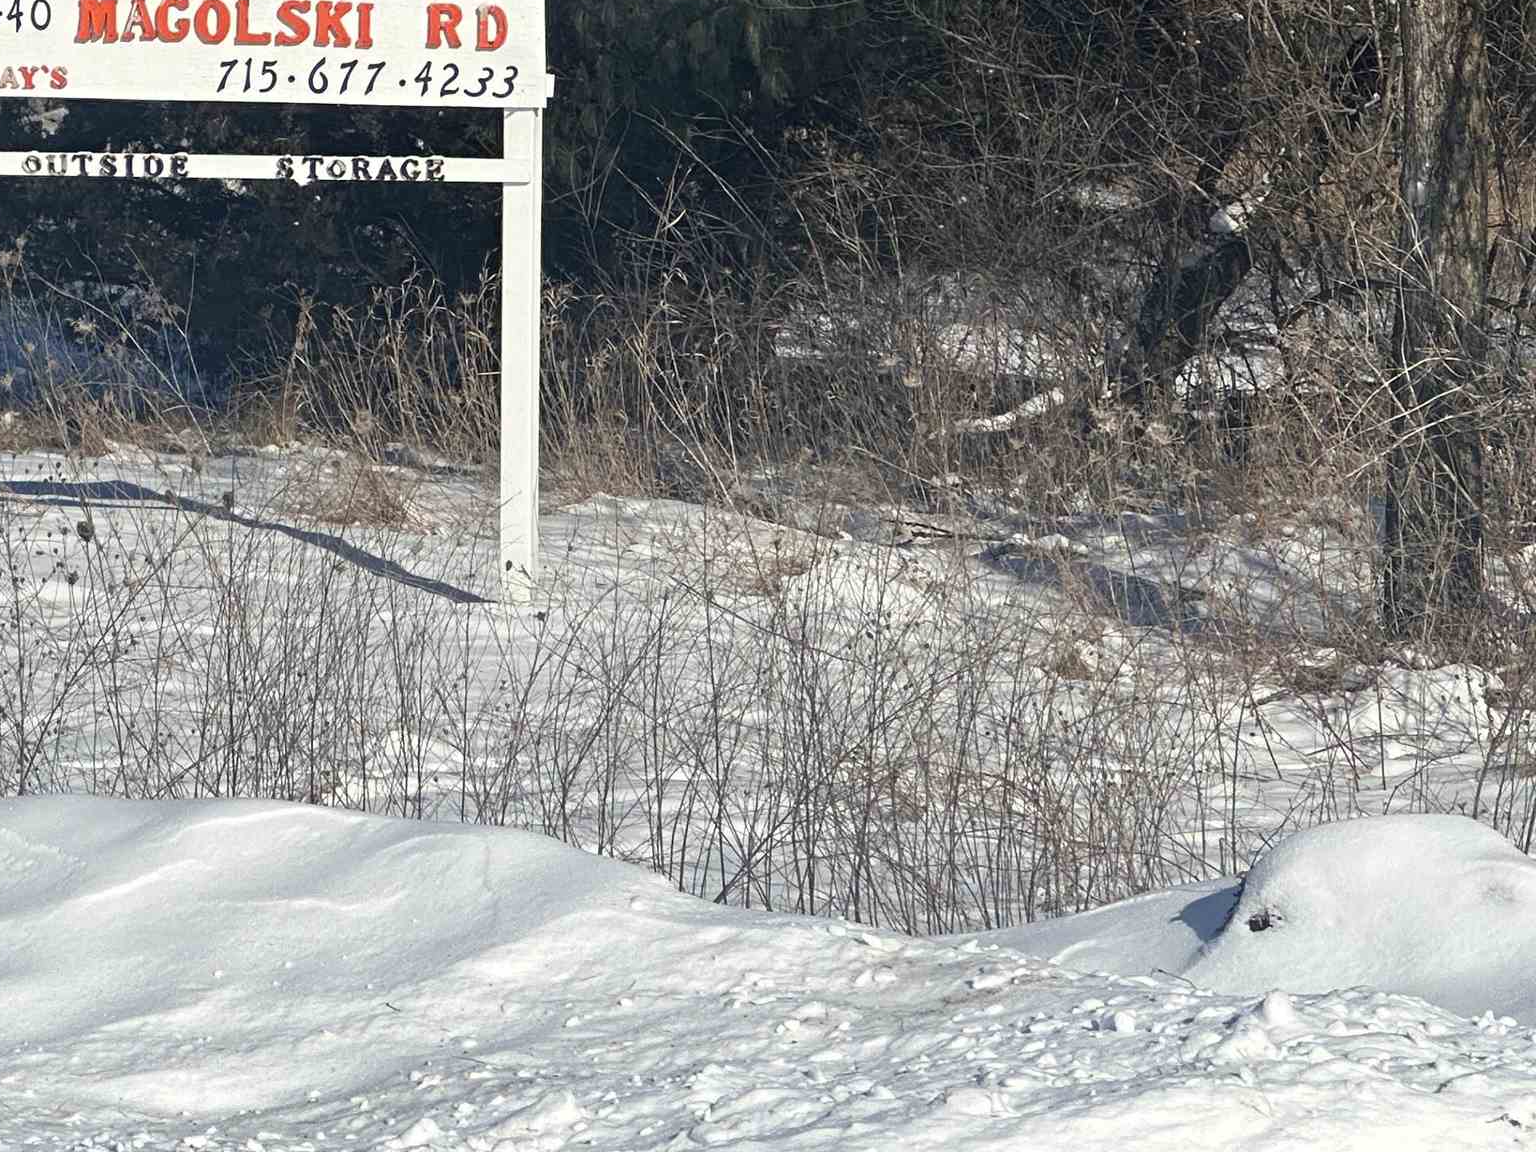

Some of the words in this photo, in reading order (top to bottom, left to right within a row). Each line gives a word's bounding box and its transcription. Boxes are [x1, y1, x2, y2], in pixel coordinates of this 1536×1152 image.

[425, 2, 509, 52] RD
[20, 154, 190, 178] OUTSIDE
[275, 157, 446, 181] STORAGE
